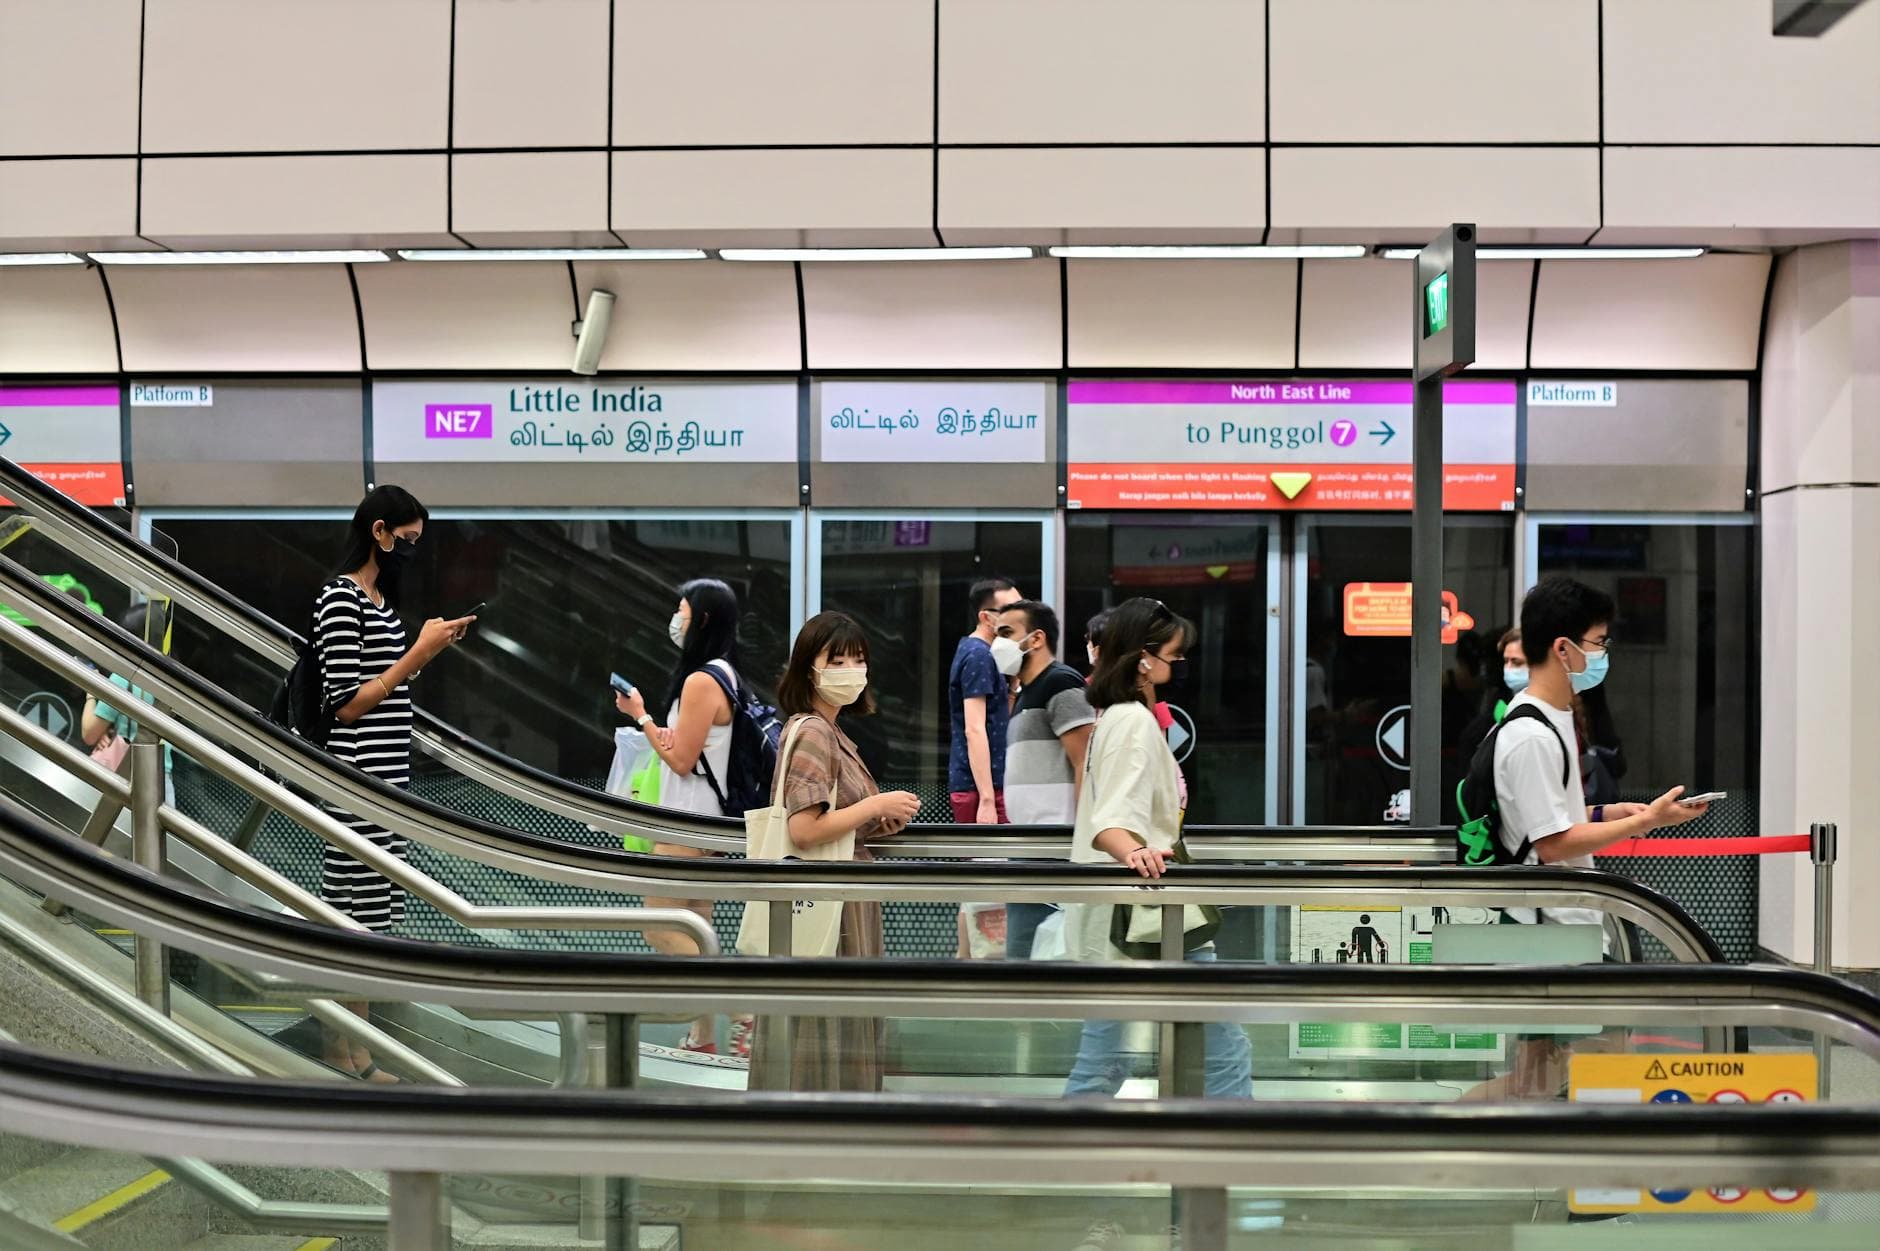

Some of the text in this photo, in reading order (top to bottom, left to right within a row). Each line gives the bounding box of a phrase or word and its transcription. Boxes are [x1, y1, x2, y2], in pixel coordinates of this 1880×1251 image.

[134, 385, 209, 401] Platform B
[511, 388, 662, 412] Little India
[1232, 384, 1351, 400] North East Line
[1533, 384, 1612, 401] Platform B
[435, 410, 482, 433] NE7
[830, 407, 1038, 437] லிட்டில் இந்தியா
[510, 421, 744, 456] லிட்டில் இந்தியா
[1187, 421, 1352, 449] to Punggol 7
[1670, 1062, 1744, 1077] CAUTION
